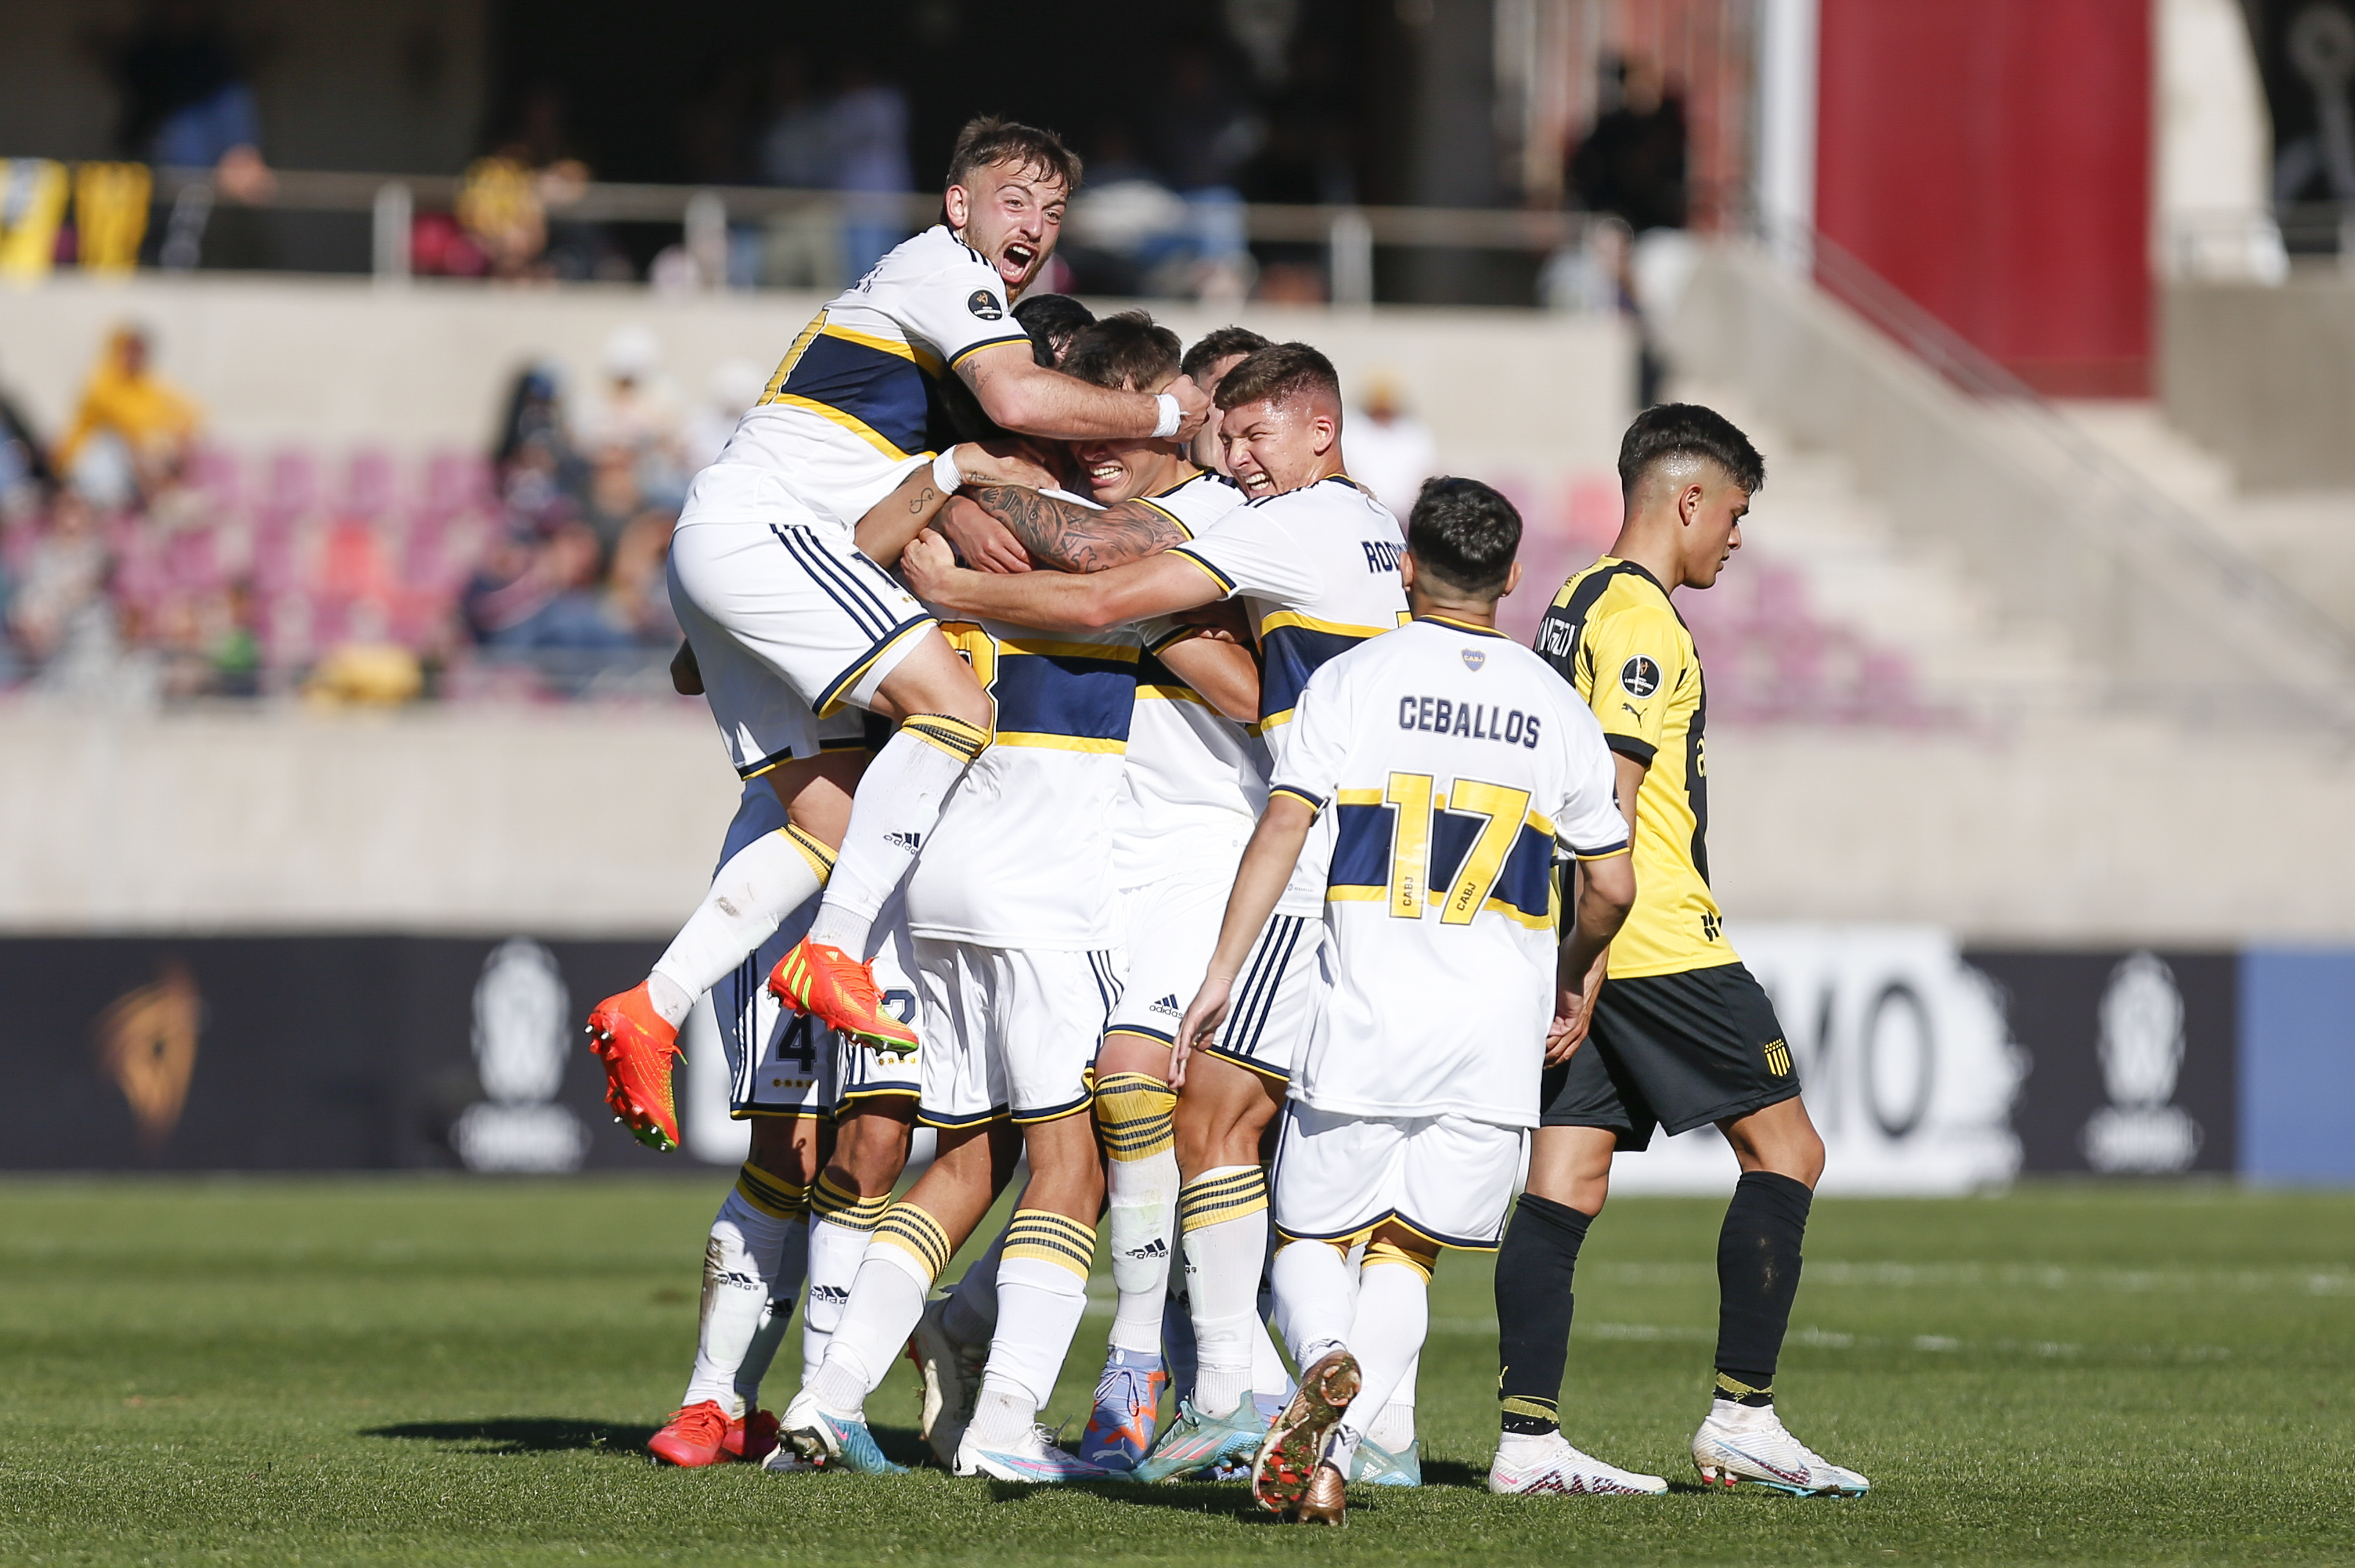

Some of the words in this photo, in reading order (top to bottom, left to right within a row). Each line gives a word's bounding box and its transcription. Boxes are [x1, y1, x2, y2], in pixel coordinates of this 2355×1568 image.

[1399, 694, 1541, 750] CEBALLOS
[1385, 770, 1533, 926] 17
[1403, 876, 1414, 906] CABJ
[1456, 881, 1477, 911] CABJ
[1149, 1005, 1183, 1019] adidas
[776, 1013, 817, 1074] 4
[1125, 1248, 1169, 1259] adidas
[1360, 1468, 1383, 1482] adidas
